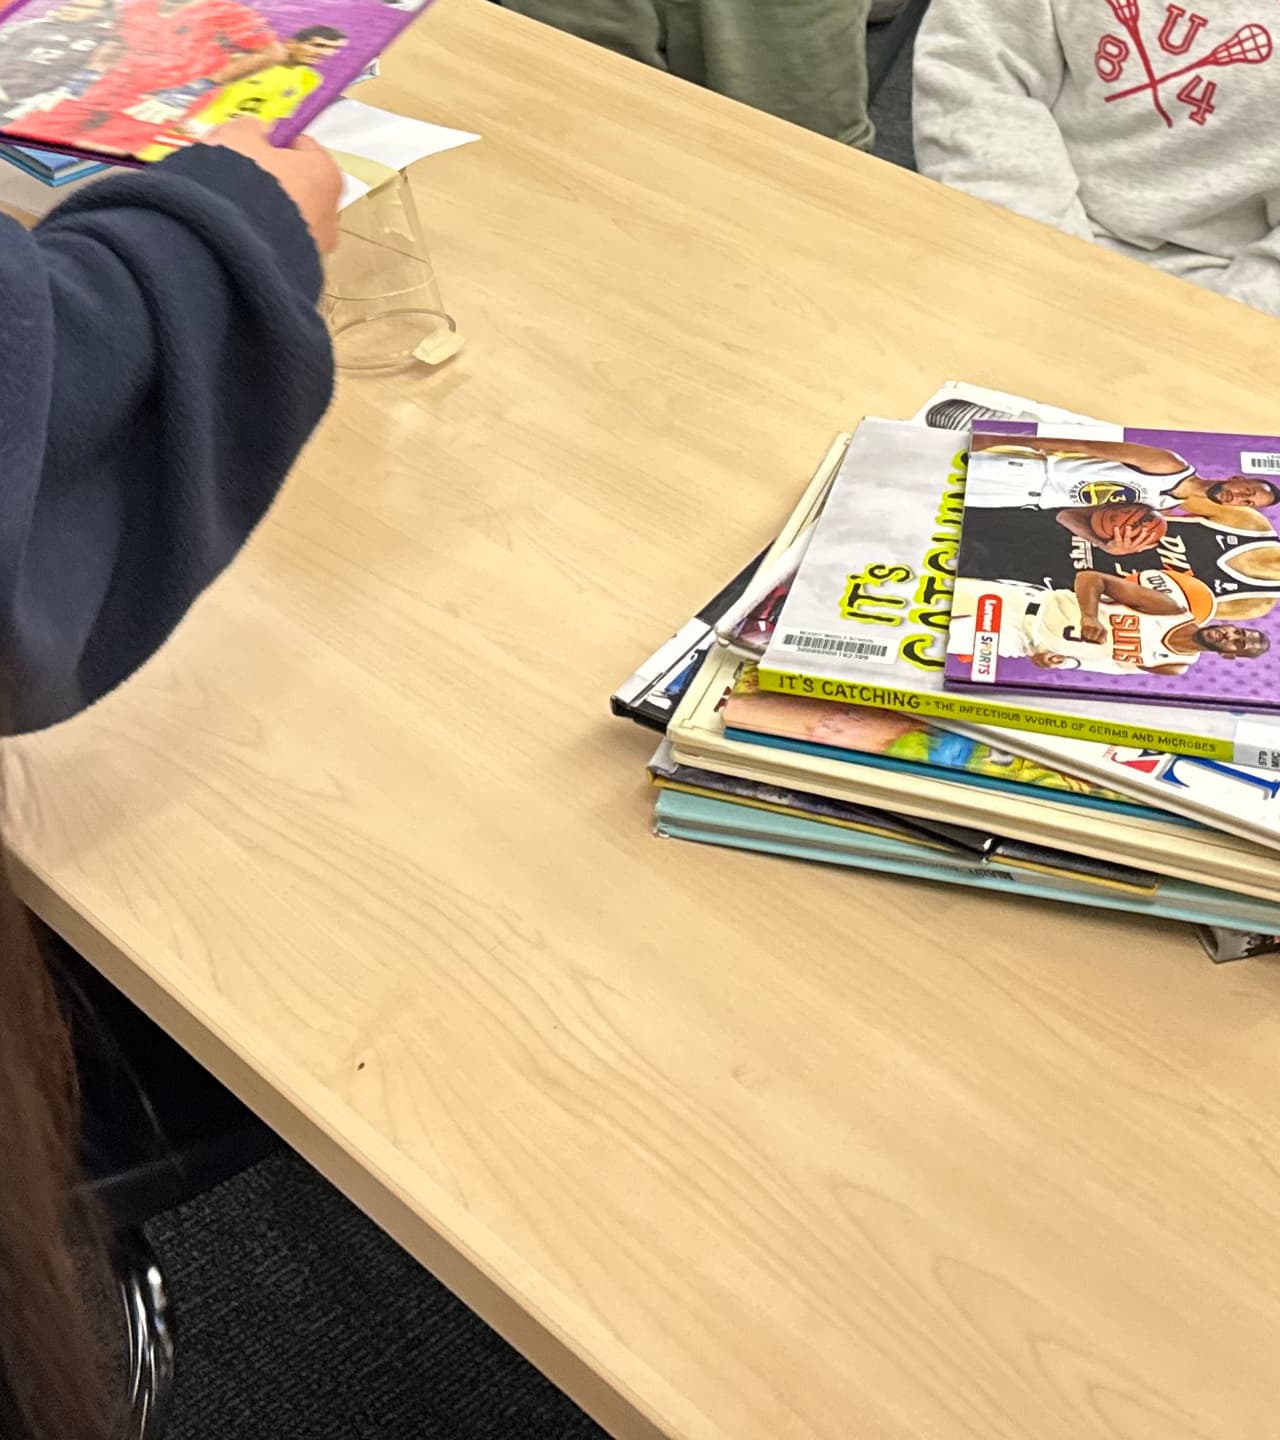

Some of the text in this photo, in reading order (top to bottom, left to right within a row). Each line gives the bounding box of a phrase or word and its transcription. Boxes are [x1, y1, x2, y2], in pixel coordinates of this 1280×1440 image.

[979, 634, 994, 676] SPORTS
[778, 672, 1217, 753] IT'S CATCHING THE INFECTIOUS WORLD OF GERMS AND MICROBES
